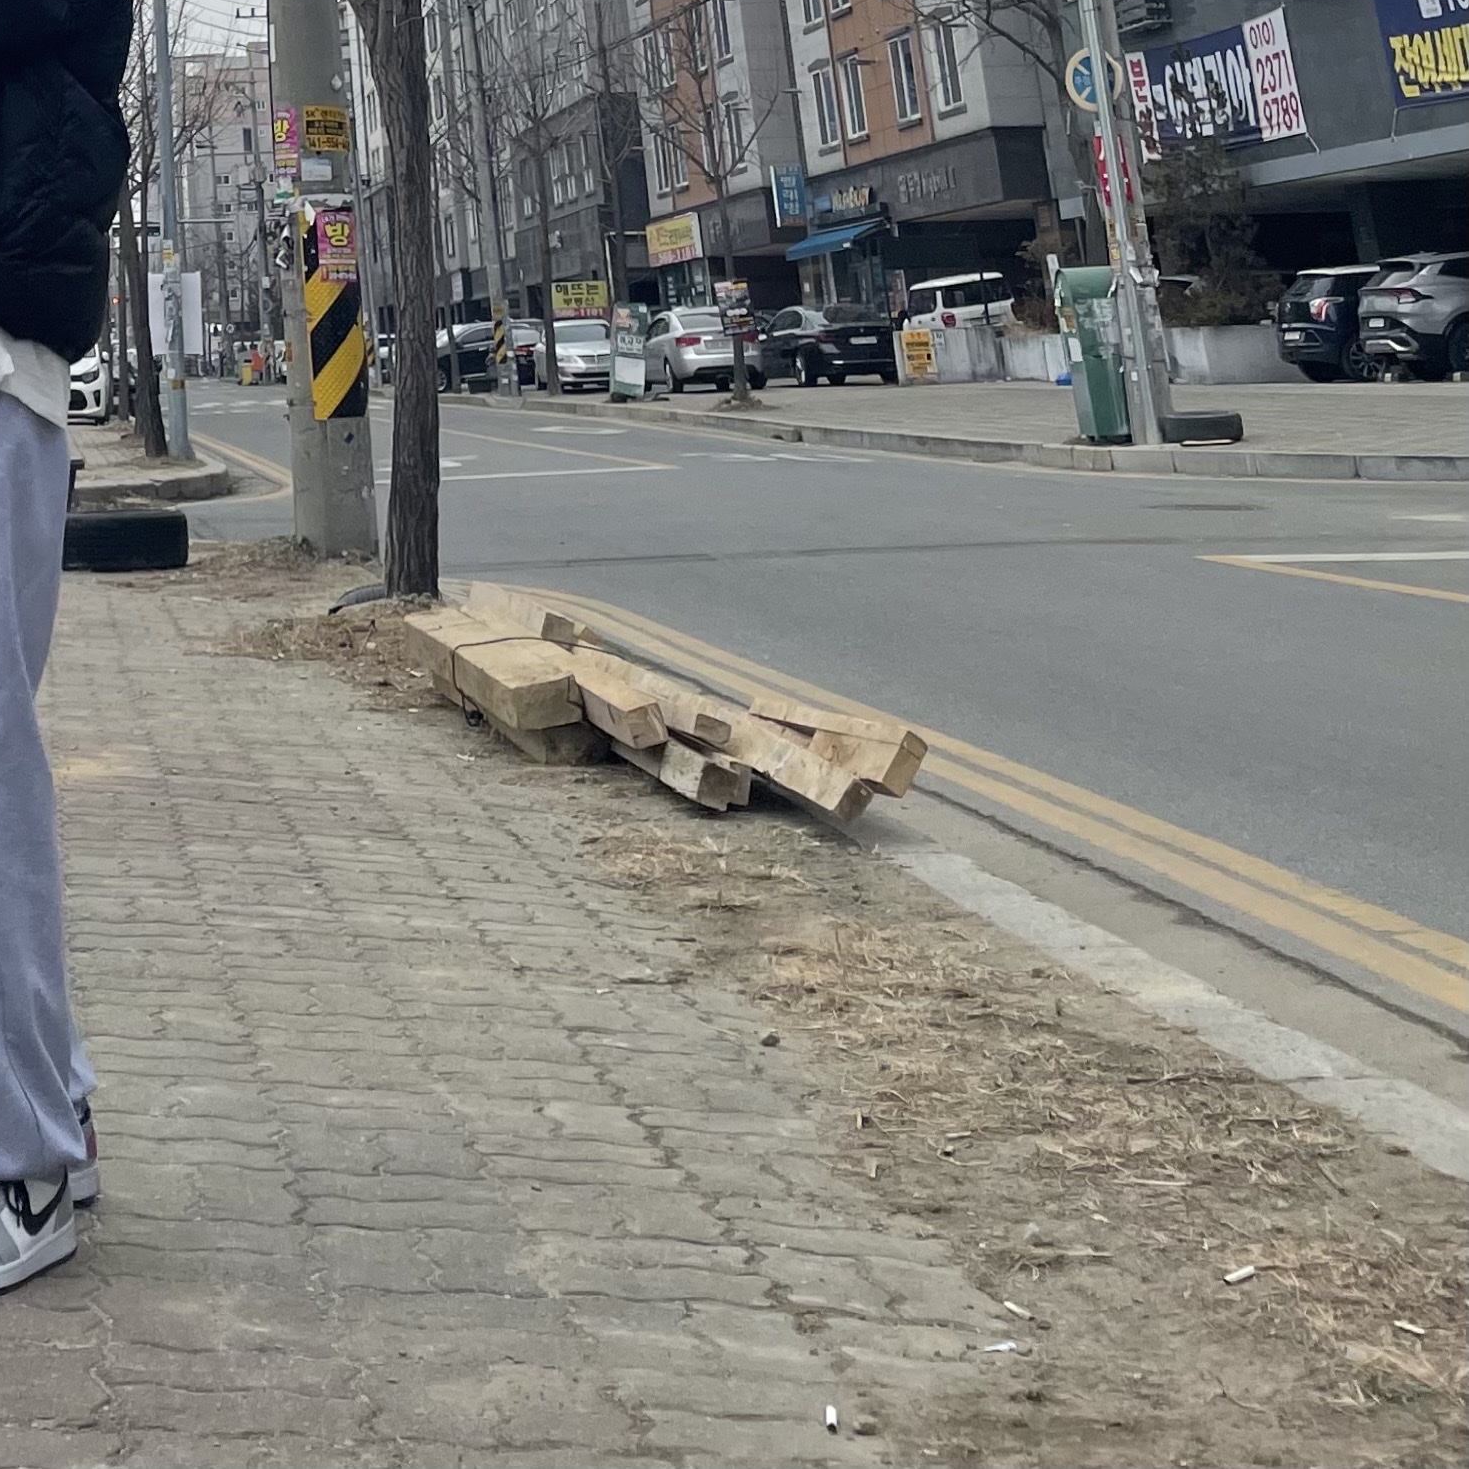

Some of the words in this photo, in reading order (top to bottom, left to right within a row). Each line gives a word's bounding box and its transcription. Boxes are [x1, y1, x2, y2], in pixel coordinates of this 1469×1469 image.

[1256, 50, 1292, 95] 2371
[1263, 92, 1300, 135] 9789
[324, 223, 350, 246] 방
